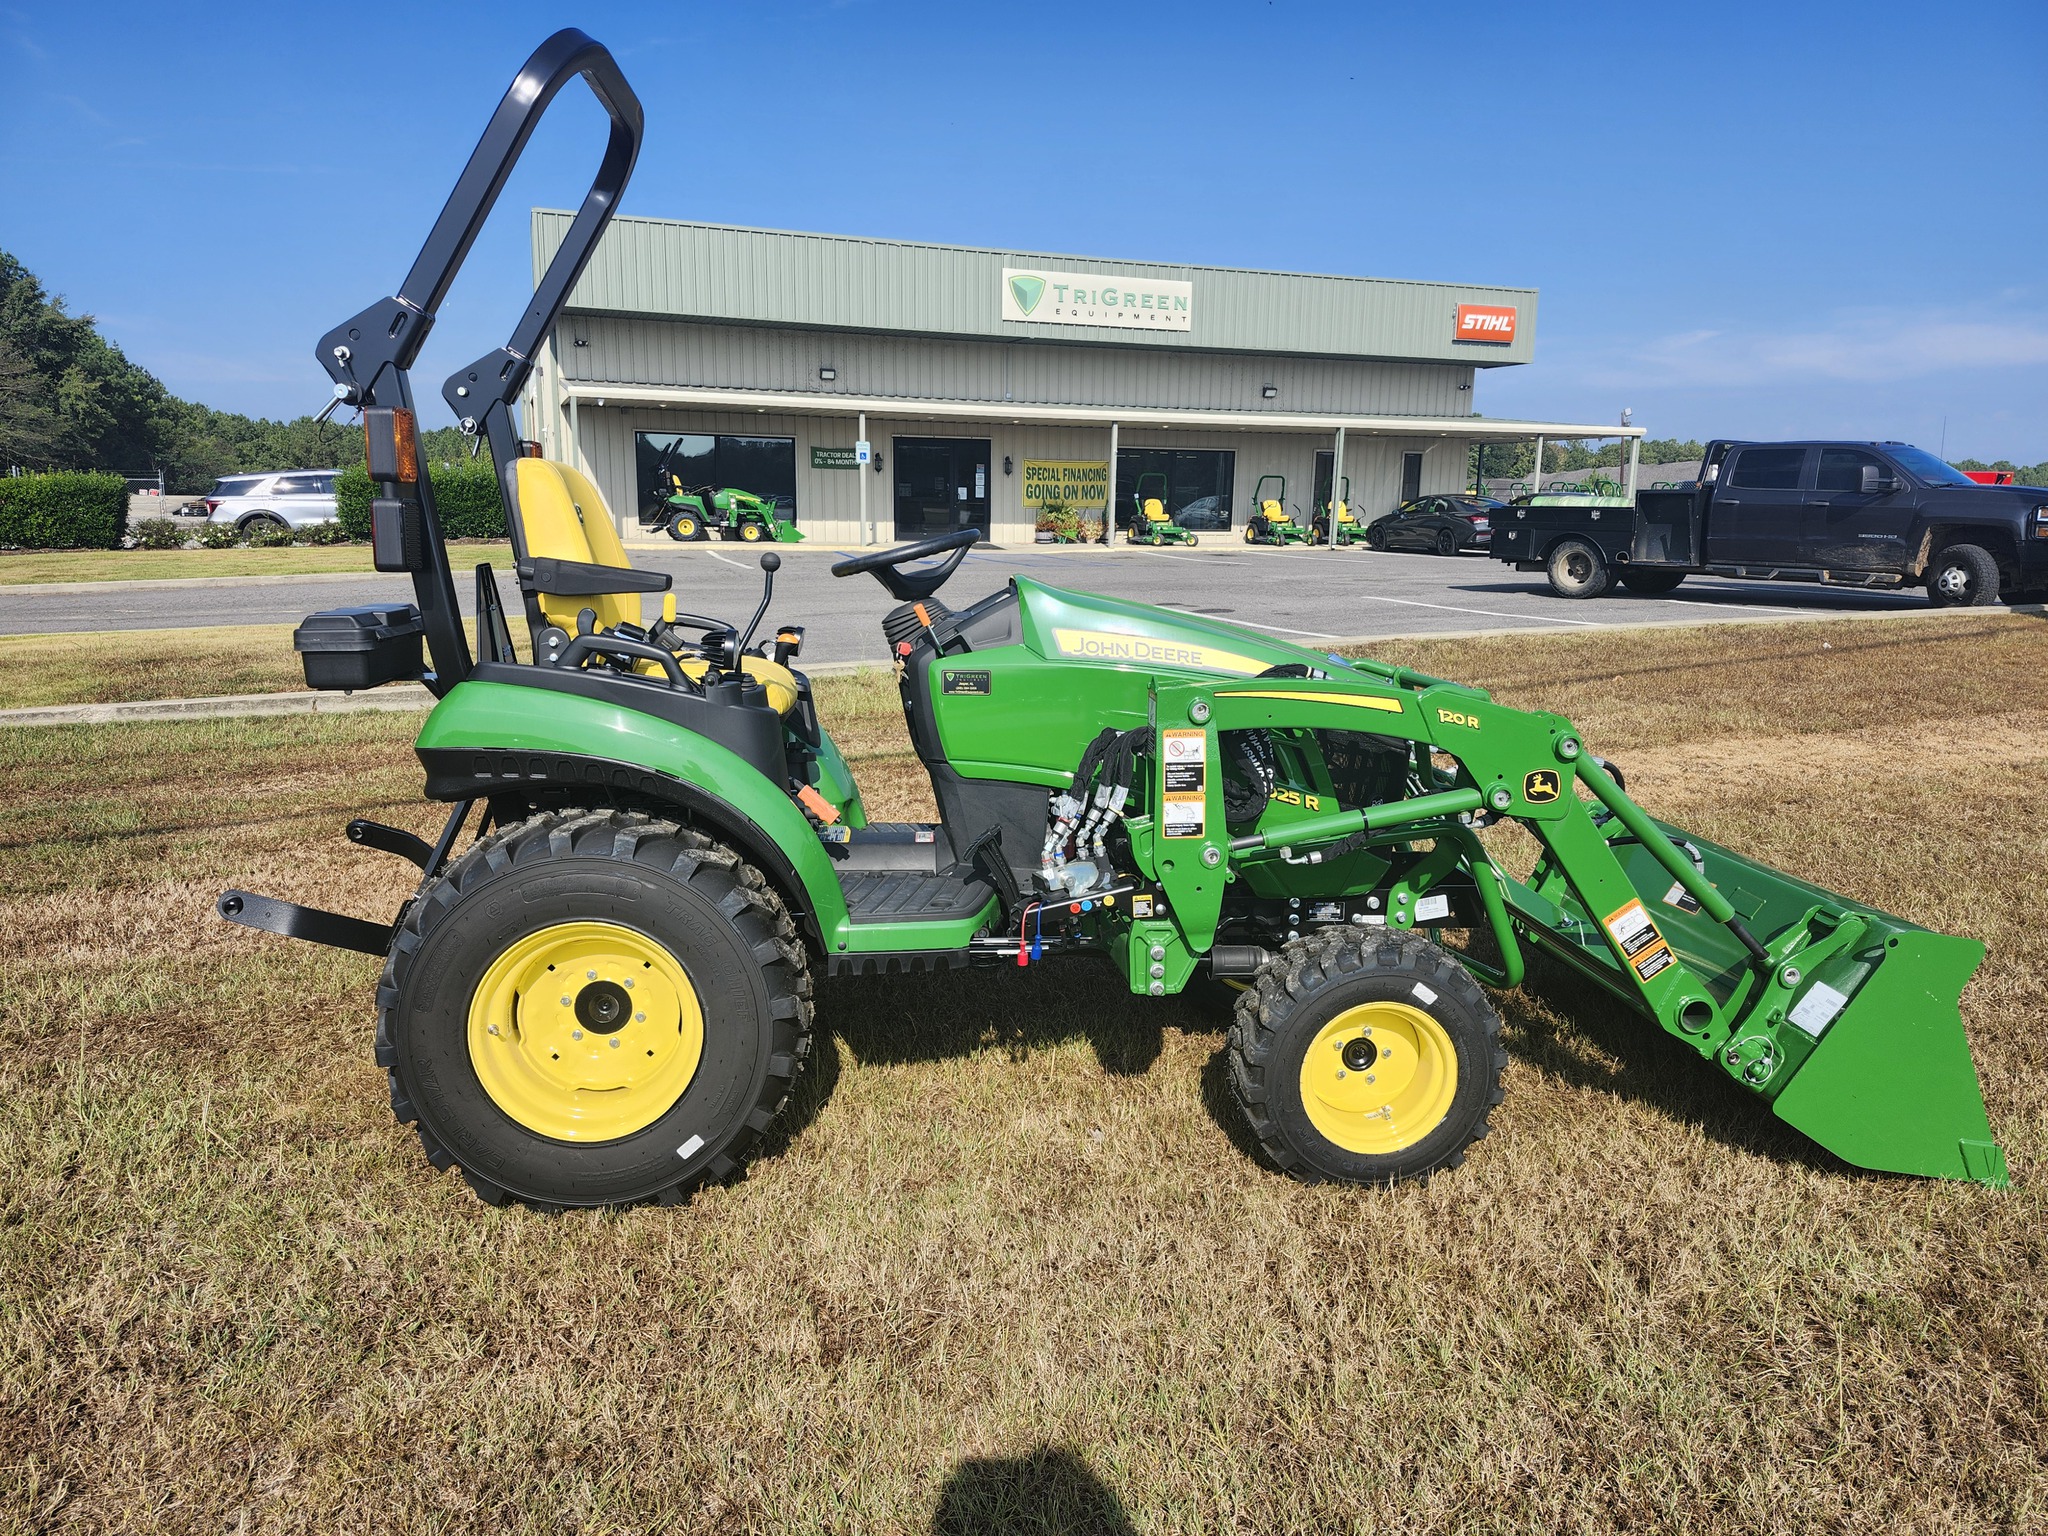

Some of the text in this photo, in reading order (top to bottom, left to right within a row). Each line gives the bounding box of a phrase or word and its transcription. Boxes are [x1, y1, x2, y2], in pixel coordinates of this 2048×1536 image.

[1053, 283, 1188, 311] TRIGREEN
[1055, 308, 1187, 323] EQUIPMENT
[1461, 314, 1512, 331] STIHL
[1025, 467, 1107, 482] SPECIAL FINANCING
[1026, 483, 1106, 500] GOING ON NOW
[1073, 637, 1203, 665] JOHN DEERE
[1437, 708, 1481, 730] 120 R
[1172, 730, 1203, 738] WARNING
[1304, 795, 1320, 812] R
